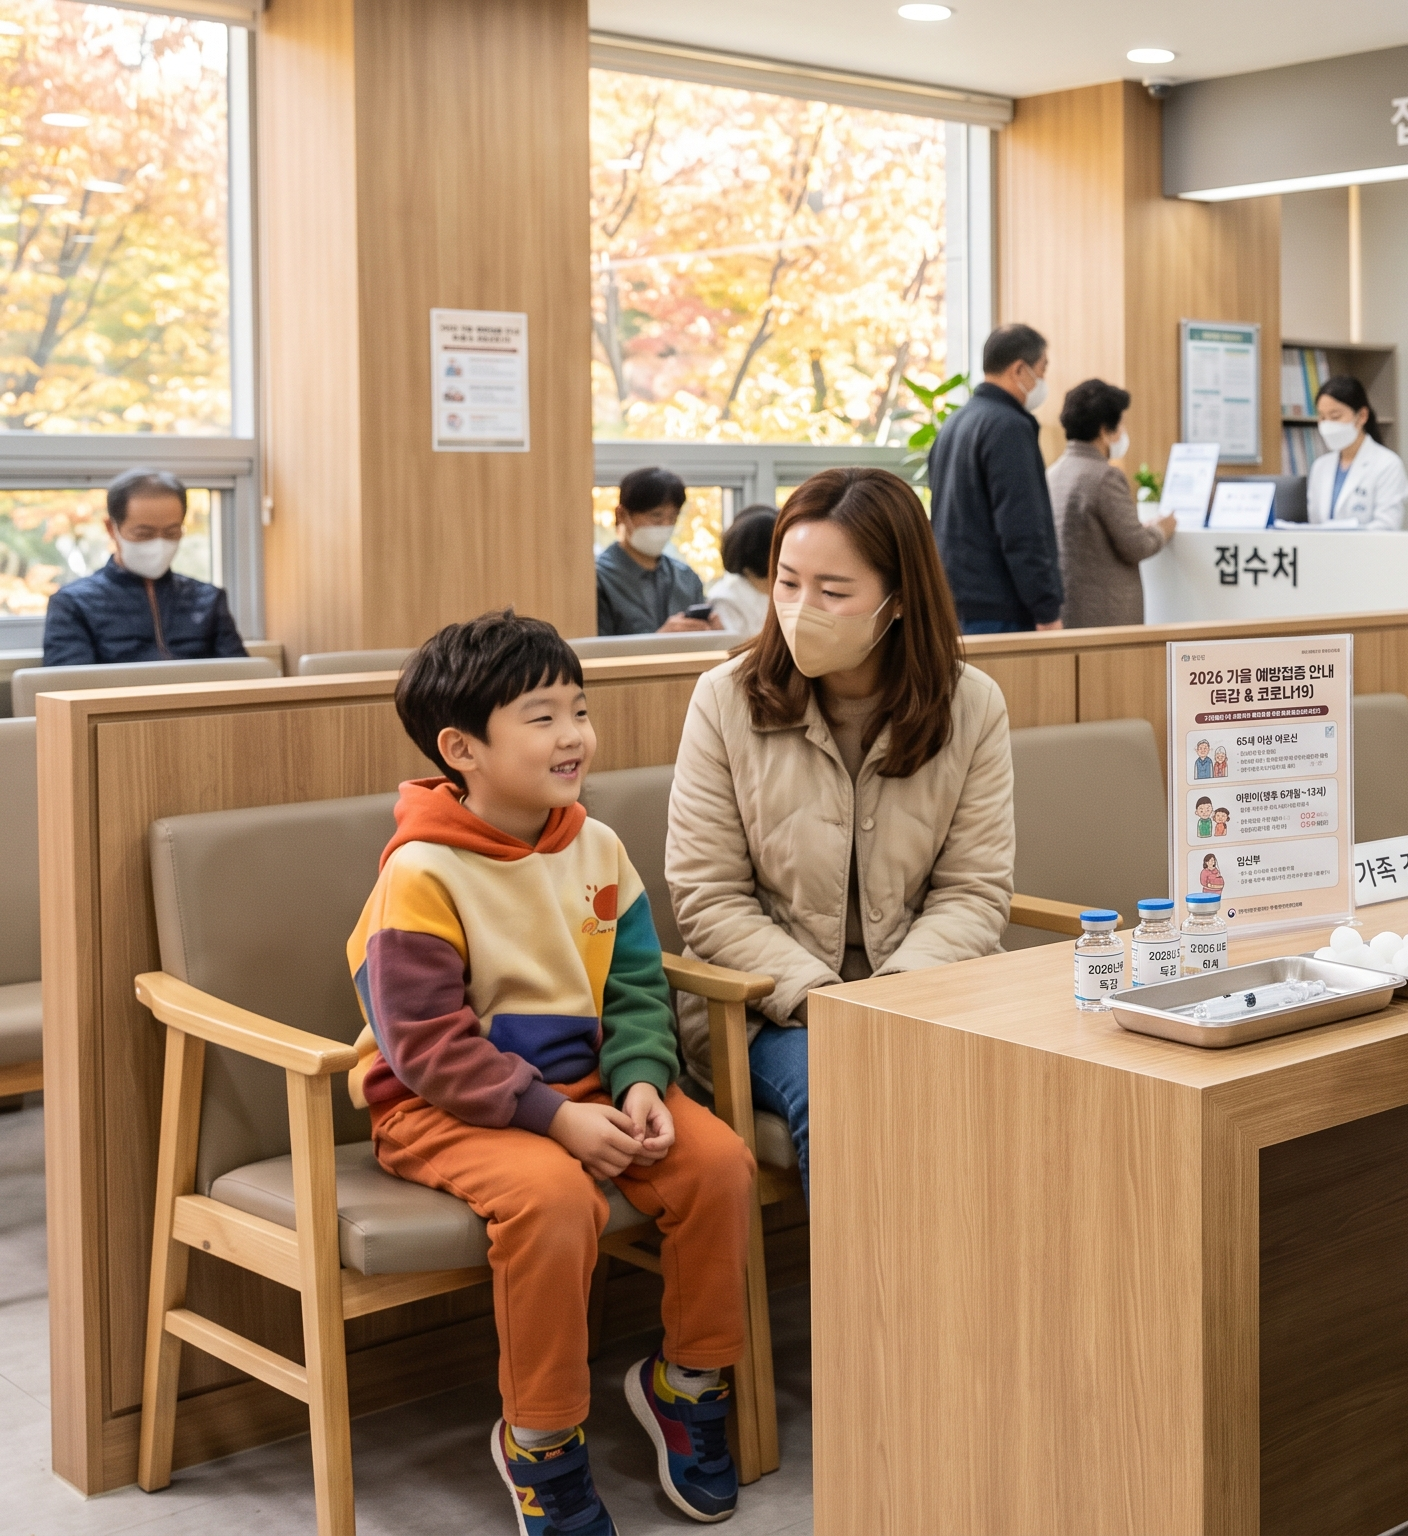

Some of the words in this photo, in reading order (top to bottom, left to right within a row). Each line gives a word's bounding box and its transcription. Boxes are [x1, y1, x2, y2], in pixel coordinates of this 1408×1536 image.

[1215, 544, 1298, 587] 접수처
[1189, 670, 1223, 685] 2026
[1227, 668, 1251, 684] 가을
[1309, 664, 1334, 680] 안내
[1244, 688, 1254, 702] &
[1257, 684, 1314, 702] 코로나19)
[1355, 856, 1397, 887] 가족
